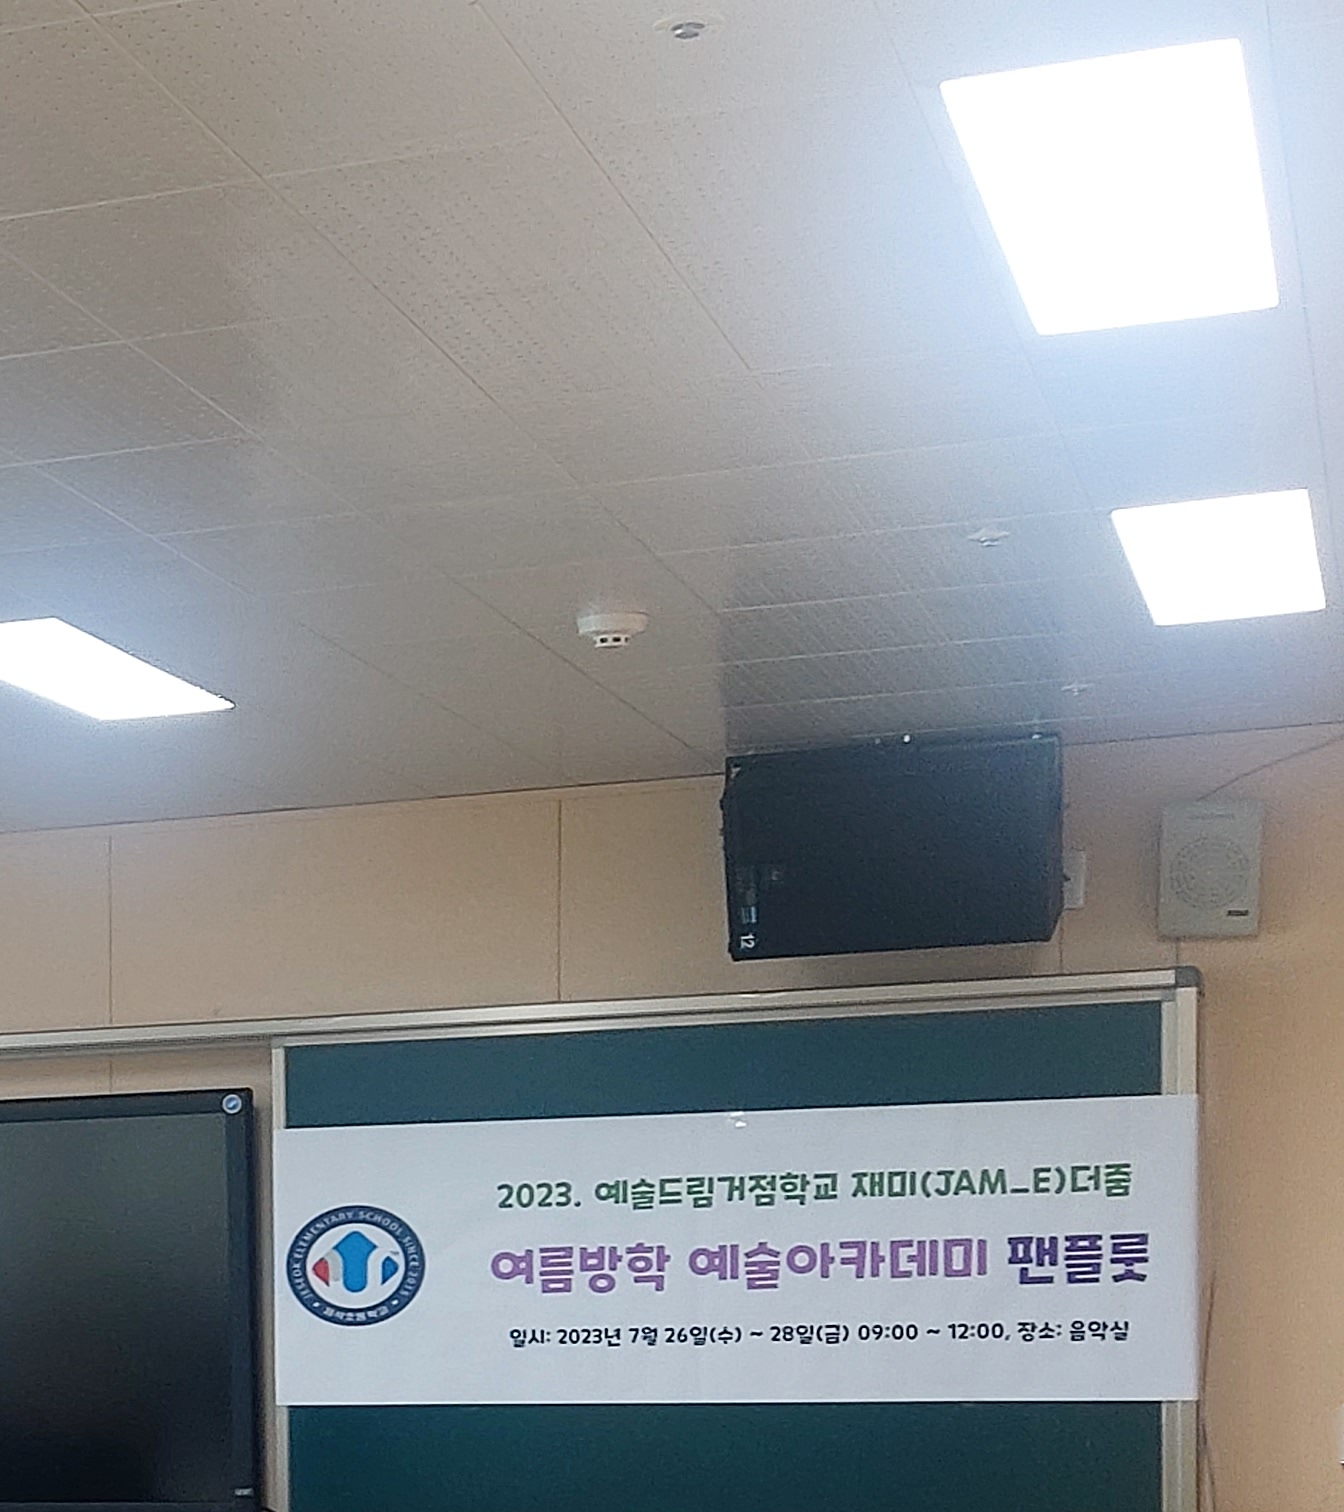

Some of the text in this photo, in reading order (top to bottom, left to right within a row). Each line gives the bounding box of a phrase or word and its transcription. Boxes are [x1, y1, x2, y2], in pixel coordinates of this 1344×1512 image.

[497, 1162, 1132, 1210] 2023. 예술드림거점학교 재미(JAM_E)더줌
[292, 1210, 354, 1259] ELEMENTARY
[357, 1210, 404, 1236] SCHOOL
[491, 1233, 1149, 1293] 여름방학 예술아카데미 팬플룻
[509, 1328, 551, 1348] 일시:
[557, 1327, 621, 1347] 2023년
[629, 1326, 658, 1345] 7월
[664, 1325, 742, 1346] 26일(수)
[770, 1323, 850, 1346] 28일(금)
[858, 1323, 918, 1341] 09:00
[948, 1323, 1011, 1341] 12:00,
[1017, 1321, 1062, 1343] 장소:
[1070, 1320, 1129, 1342] 음악실
